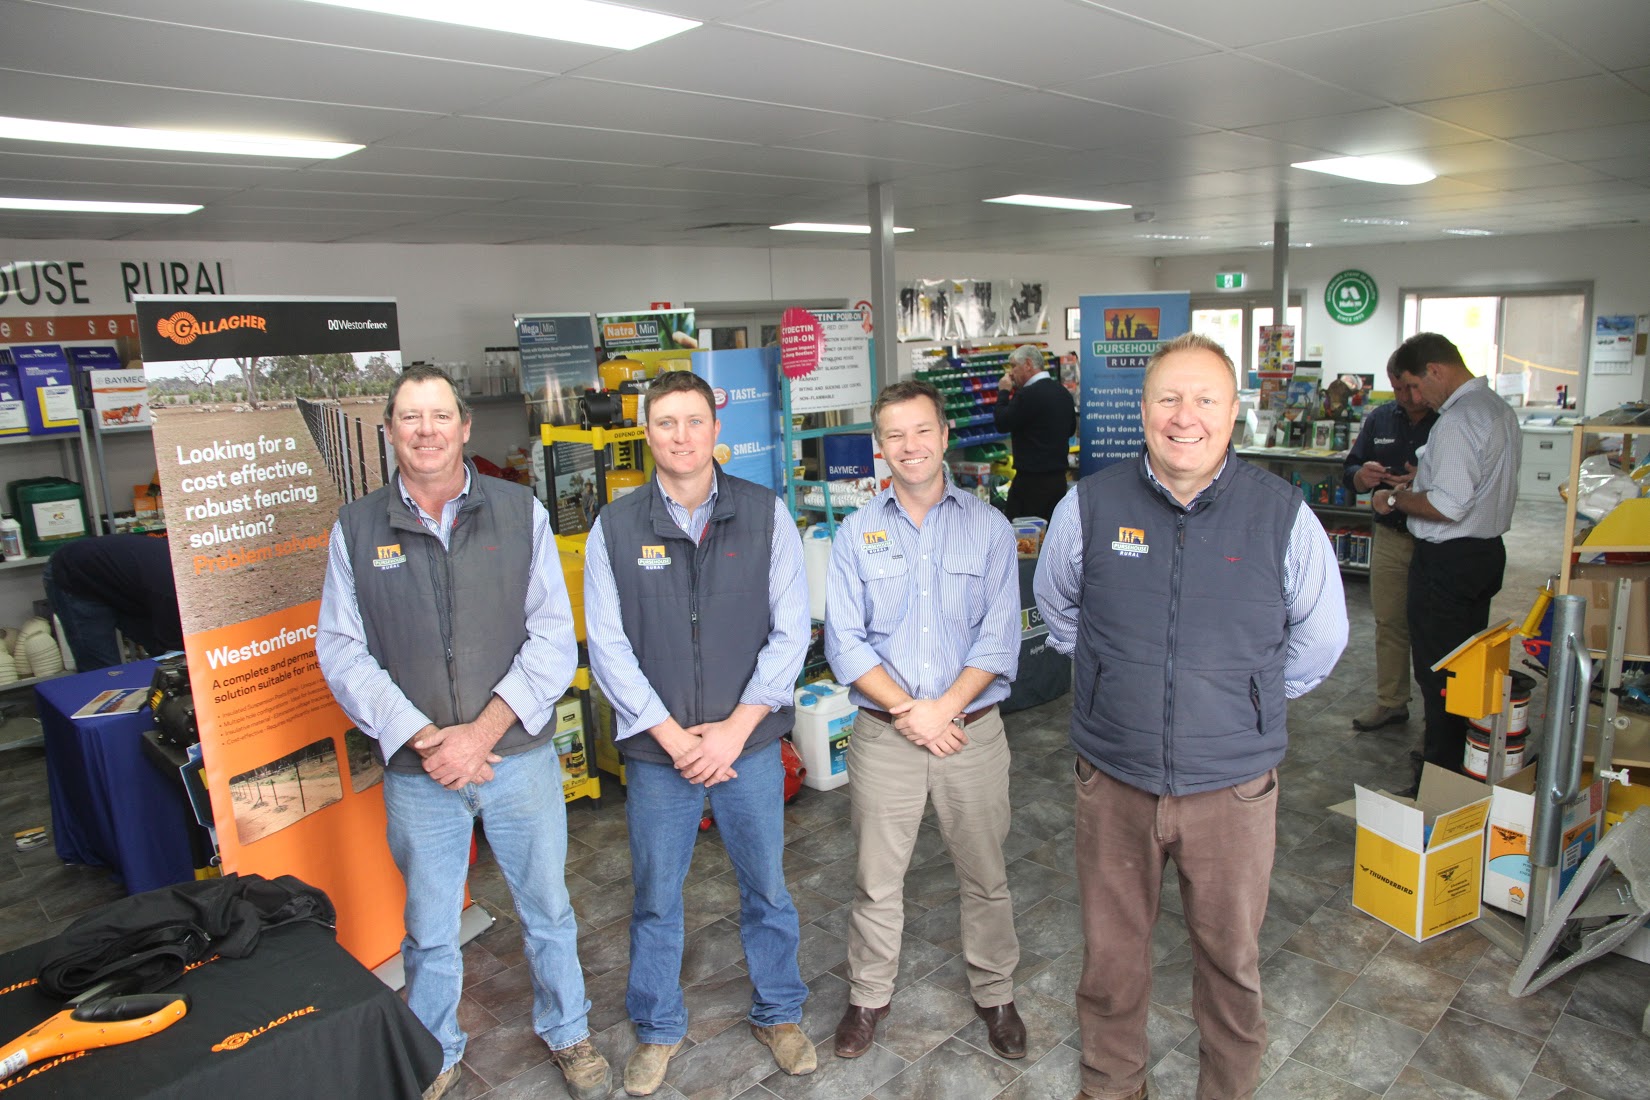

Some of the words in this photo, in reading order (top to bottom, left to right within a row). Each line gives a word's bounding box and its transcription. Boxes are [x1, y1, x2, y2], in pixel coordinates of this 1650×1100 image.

[174, 315, 267, 337] GALLAGHER
[338, 319, 388, 331] Westonfence
[521, 324, 540, 336] Mega
[542, 323, 555, 333] Min
[607, 326, 634, 337] Natra
[638, 323, 656, 334] Min
[1096, 343, 1160, 354] PURSEHOUS
[1111, 358, 1149, 366] RURA
[104, 376, 145, 385] BAYMEC
[730, 388, 756, 400] TASTE
[1115, 400, 1135, 408] going
[176, 440, 256, 465] Looking
[257, 434, 282, 454] for
[284, 437, 296, 450] a
[733, 441, 760, 455] SMELL
[181, 470, 227, 493] cost
[230, 459, 313, 486] effective,
[829, 465, 859, 474] BAYMEC
[185, 492, 252, 521] robust
[253, 483, 318, 509] fencing
[189, 513, 275, 548] solution?
[192, 545, 273, 575] Problem
[1119, 550, 1140, 558] RURAL
[1031, 611, 1041, 623] So
[206, 624, 317, 669] Westonfenc
[212, 679, 221, 690] A
[222, 666, 269, 687] complete
[270, 658, 287, 672] and
[214, 685, 257, 704] solution
[257, 670, 292, 690] suitable
[292, 666, 305, 676] for
[306, 661, 319, 672] int
[1368, 869, 1414, 896] THUNDERBIRD
[228, 1005, 315, 1046] GALLAGHER
